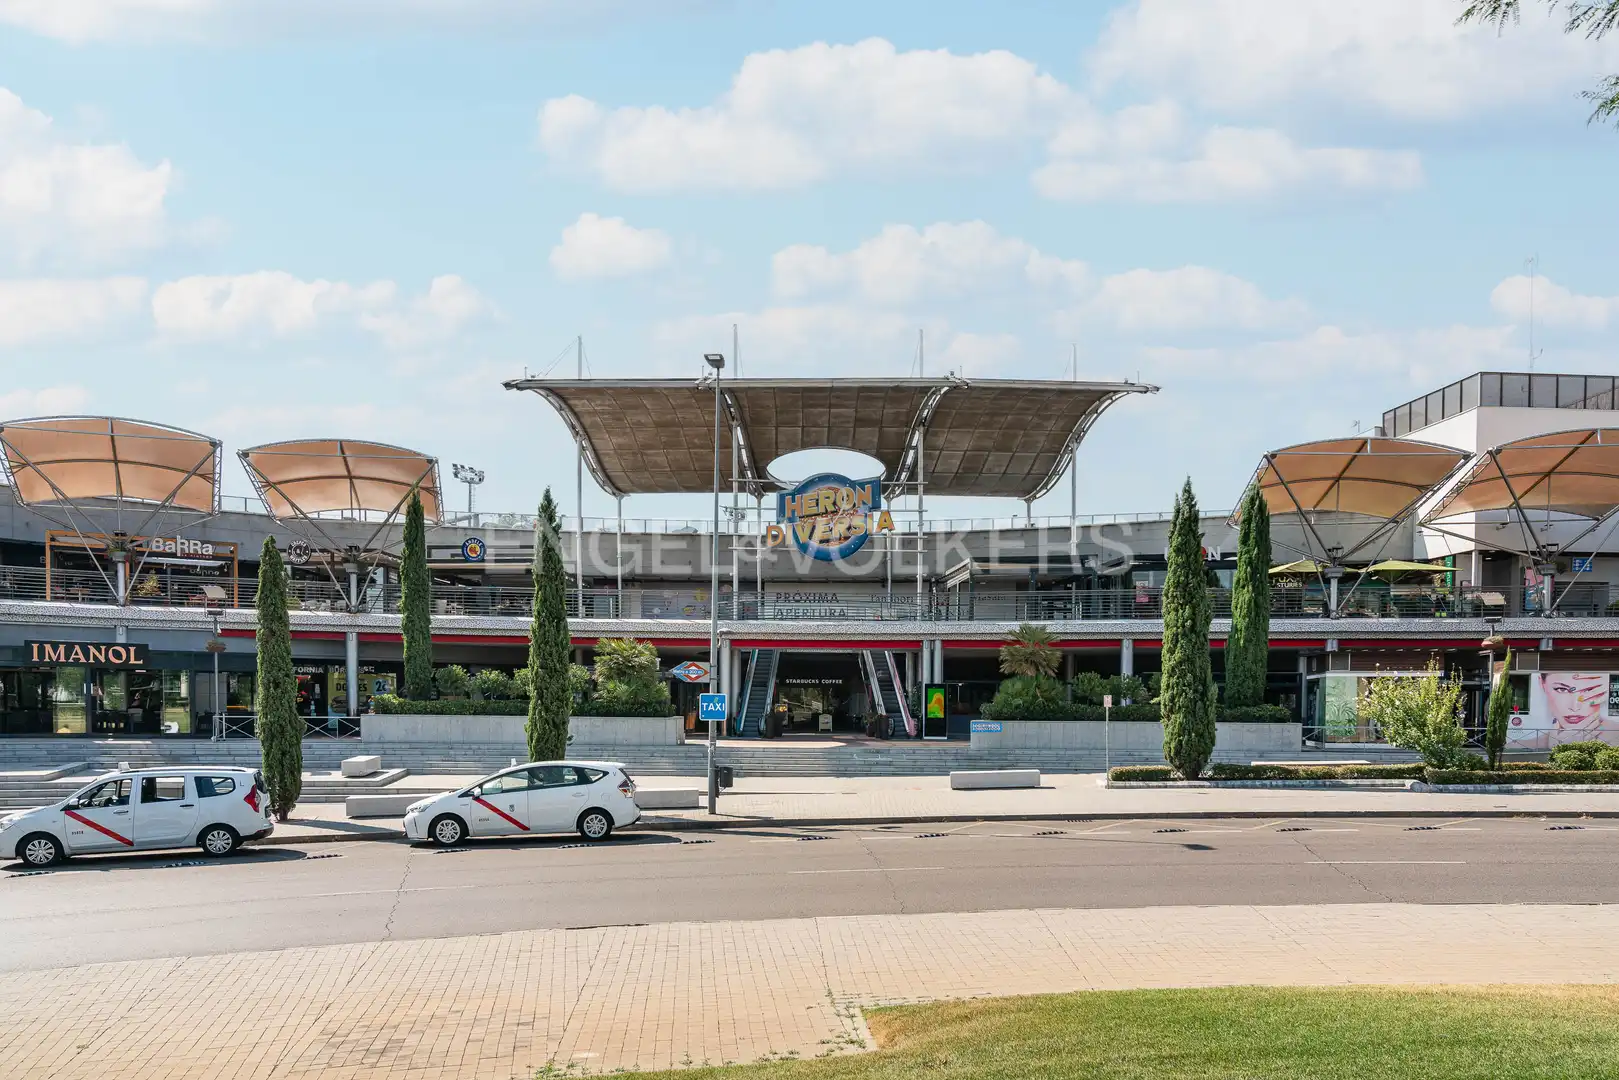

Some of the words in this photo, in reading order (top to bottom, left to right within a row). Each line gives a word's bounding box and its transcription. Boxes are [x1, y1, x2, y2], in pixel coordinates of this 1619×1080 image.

[785, 484, 873, 518] HERON
[766, 510, 896, 548] DIVERSIA
[31, 643, 144, 664] IMANOL
[701, 702, 725, 711] TAXI
